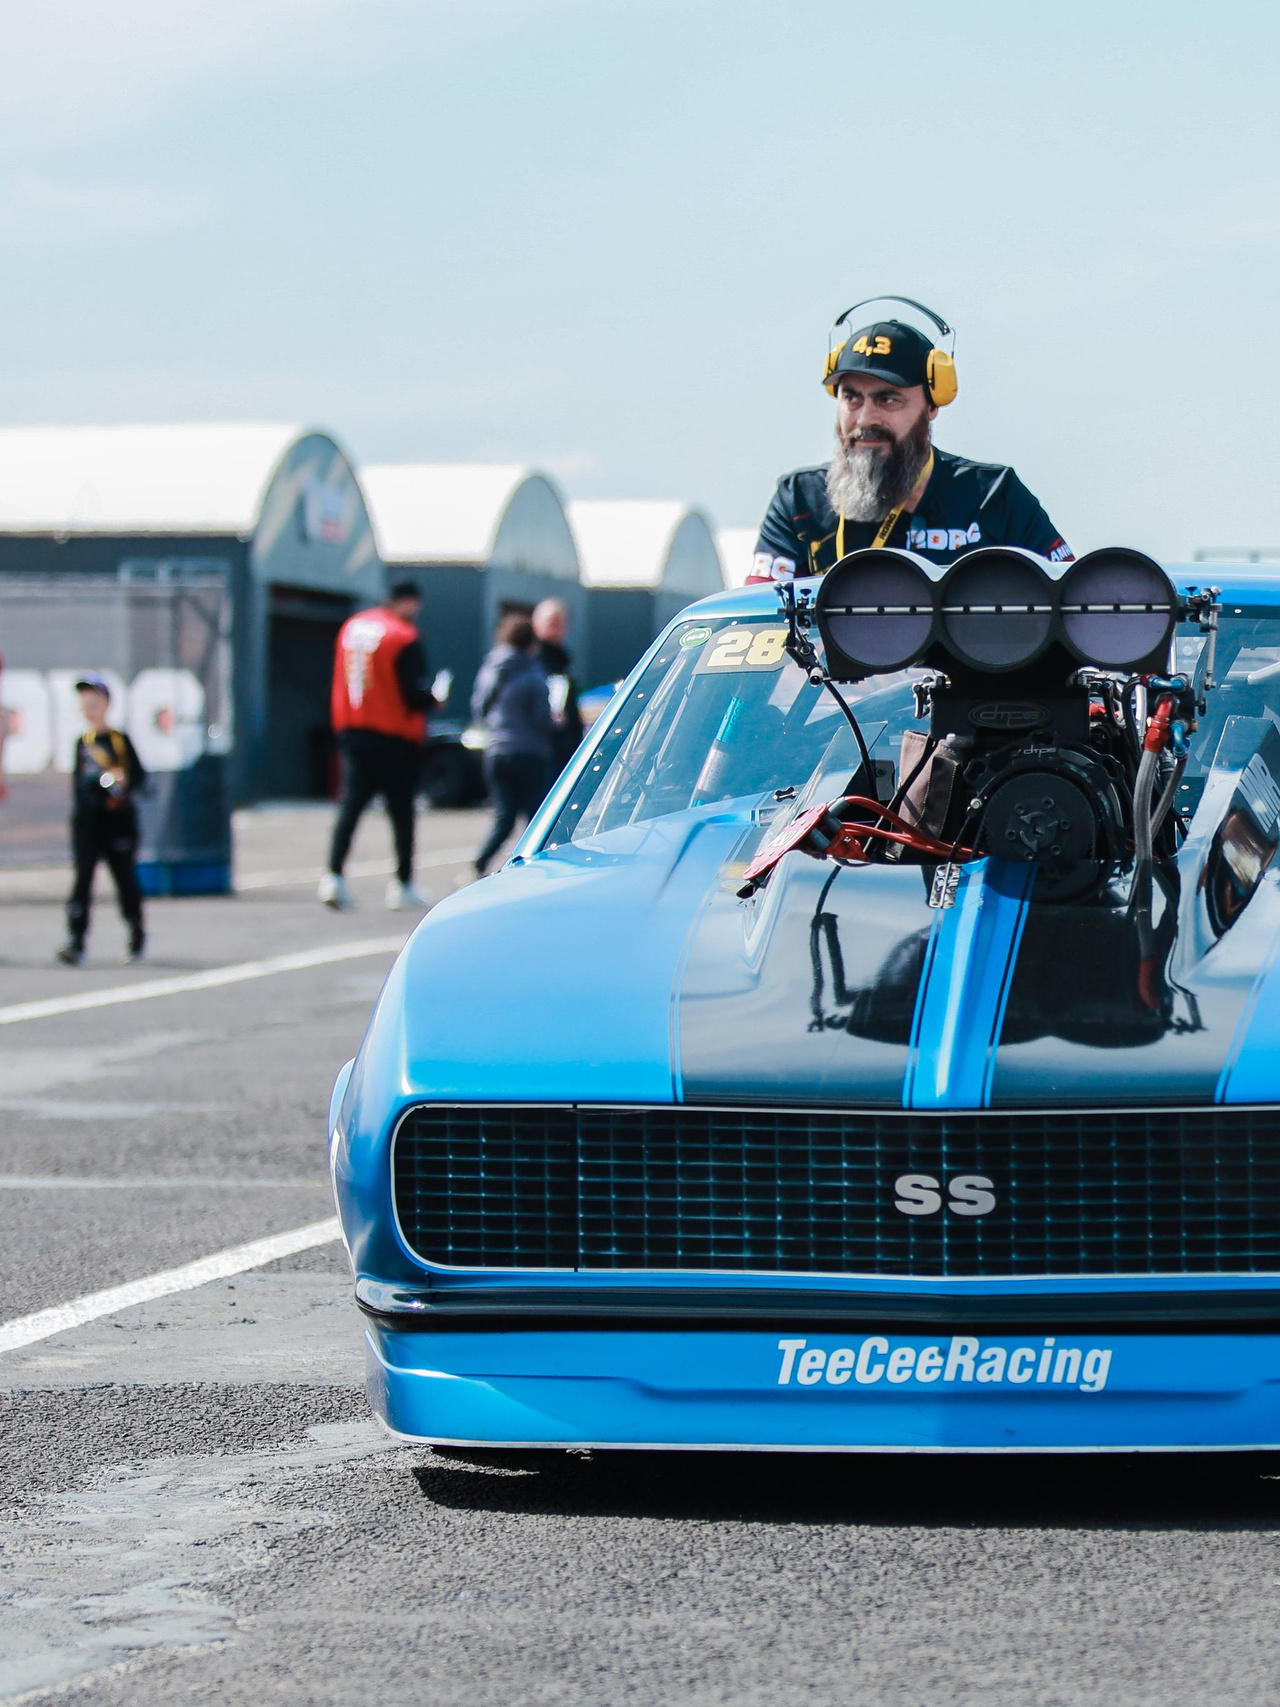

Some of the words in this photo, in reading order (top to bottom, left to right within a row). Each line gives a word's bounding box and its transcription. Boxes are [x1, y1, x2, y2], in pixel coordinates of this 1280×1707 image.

[706, 630, 790, 668] 28
[894, 1174, 996, 1216] SS
[777, 1336, 1113, 1393] TeeCeeRacing
